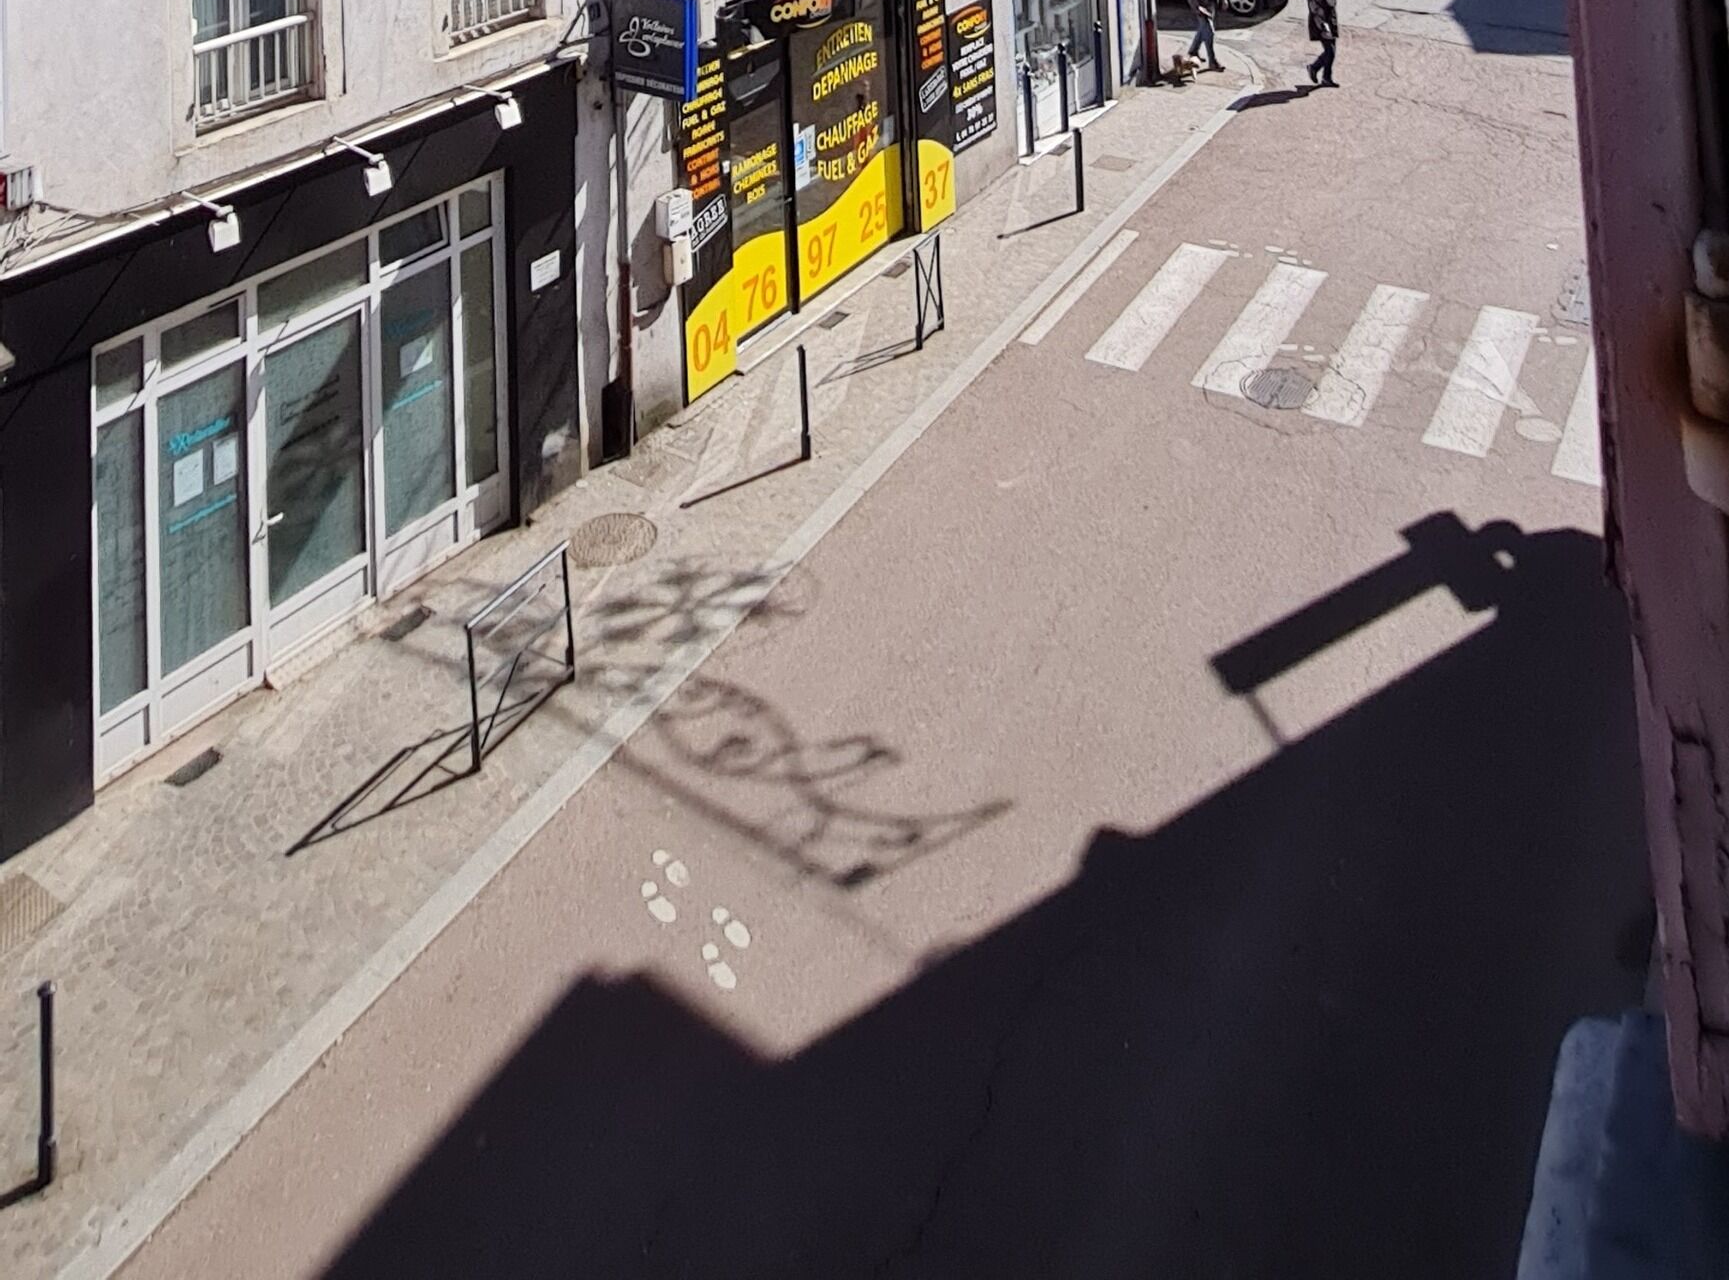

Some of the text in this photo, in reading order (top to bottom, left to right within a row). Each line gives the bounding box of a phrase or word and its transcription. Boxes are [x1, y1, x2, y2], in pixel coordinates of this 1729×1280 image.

[816, 22, 873, 68] ENTRETIEN
[816, 101, 879, 151] CHAUFFAGE
[817, 124, 879, 181] FUEL & GAZ
[747, 184, 765, 204] BOIS
[692, 160, 950, 372] 04 76 97 25 37
